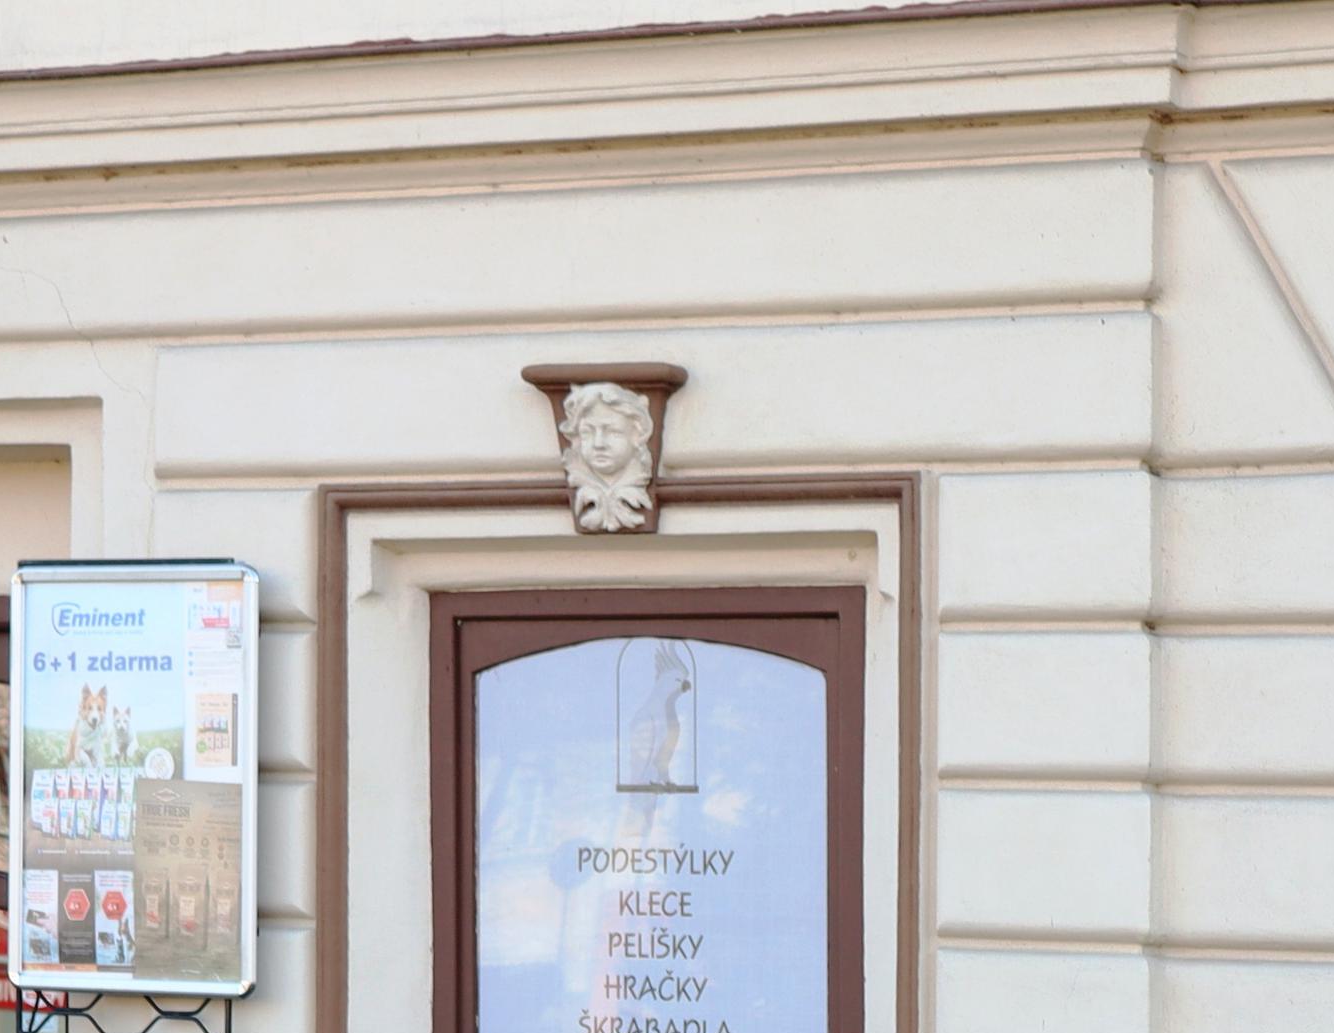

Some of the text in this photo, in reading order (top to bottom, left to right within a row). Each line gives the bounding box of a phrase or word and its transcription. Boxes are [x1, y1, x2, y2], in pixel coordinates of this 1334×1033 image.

[58, 607, 146, 627] Eminent
[87, 651, 173, 672] zdarma
[578, 842, 734, 877] PODESTÝLKY
[618, 890, 693, 918] KLECE
[608, 926, 704, 960] PELÍŠKY
[603, 968, 708, 1003] HRAČKY
